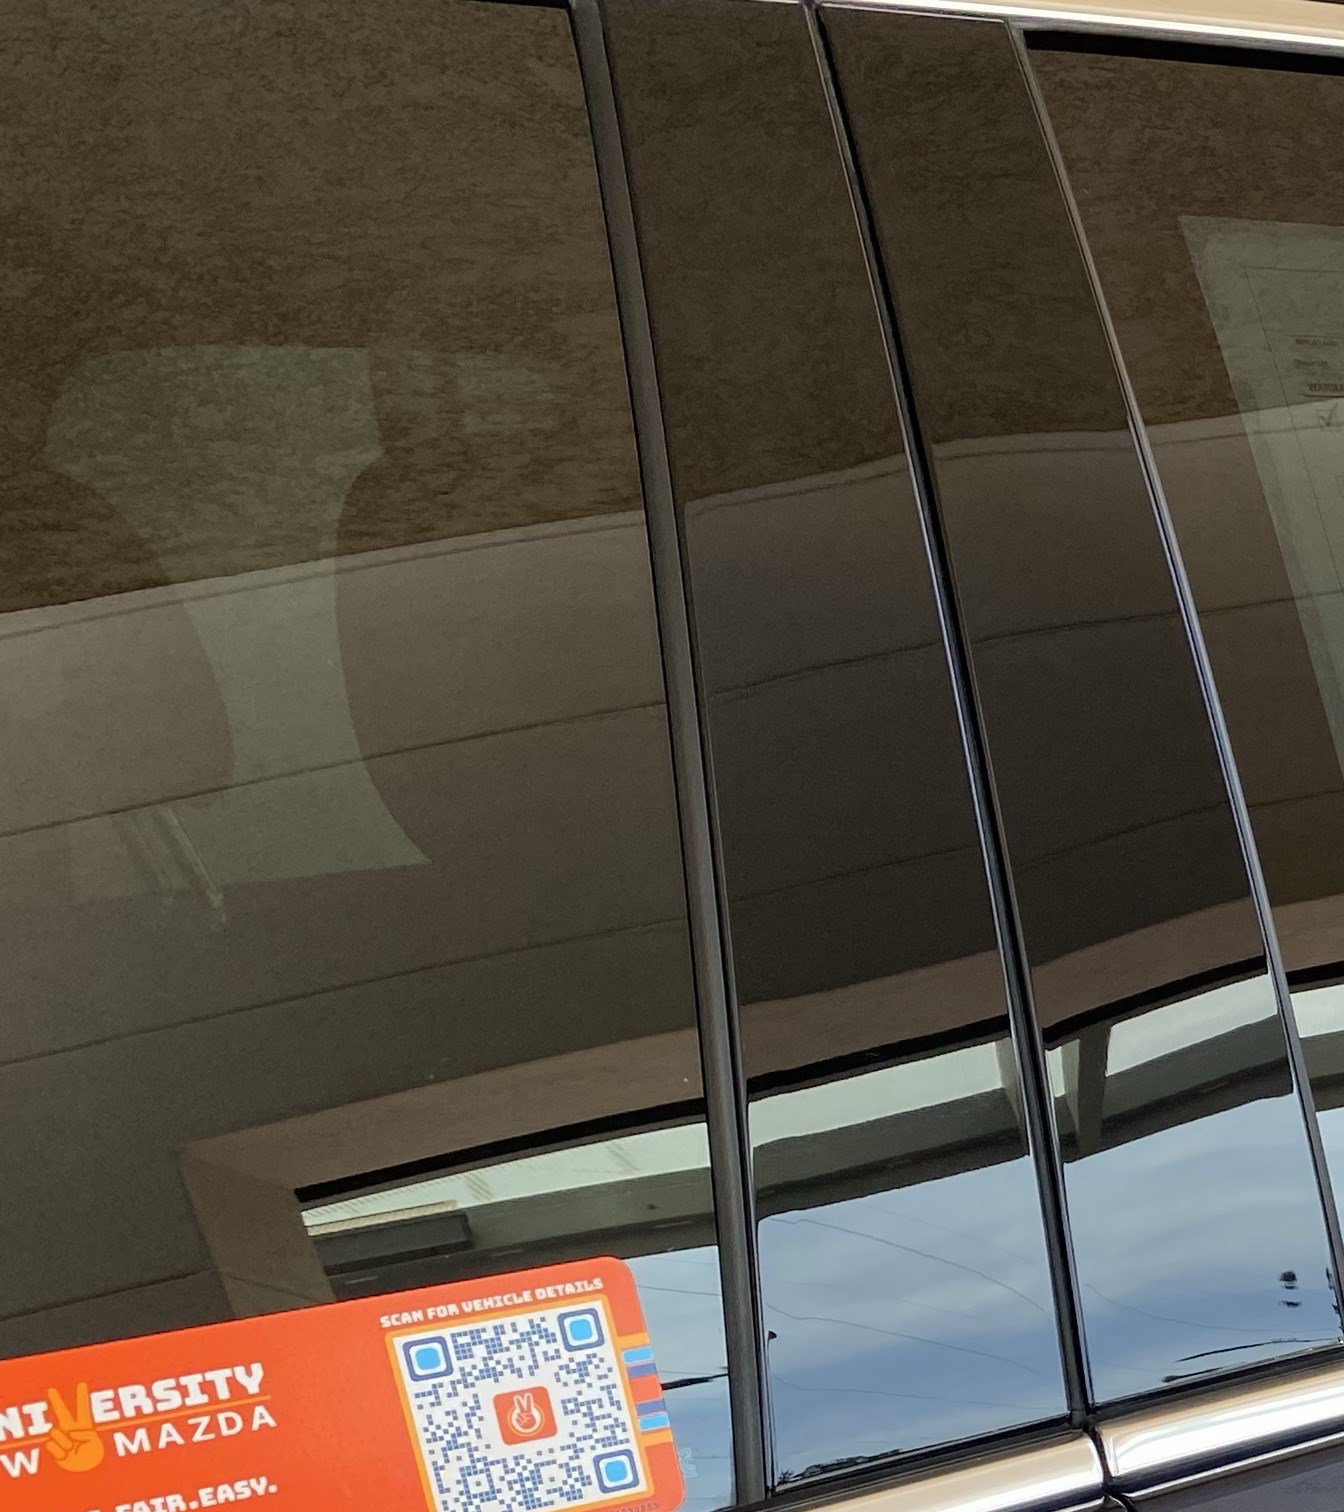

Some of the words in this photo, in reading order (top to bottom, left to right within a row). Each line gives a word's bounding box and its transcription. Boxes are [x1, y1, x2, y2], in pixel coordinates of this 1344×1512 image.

[379, 1309, 425, 1328] SCAN
[427, 1303, 460, 1321] FOR
[462, 1290, 534, 1313] VEHICLE
[535, 1278, 604, 1300] DETAILS
[0, 1362, 264, 1442] NIVERSITY
[0, 1448, 40, 1478] W
[113, 1405, 277, 1457] MAZDA
